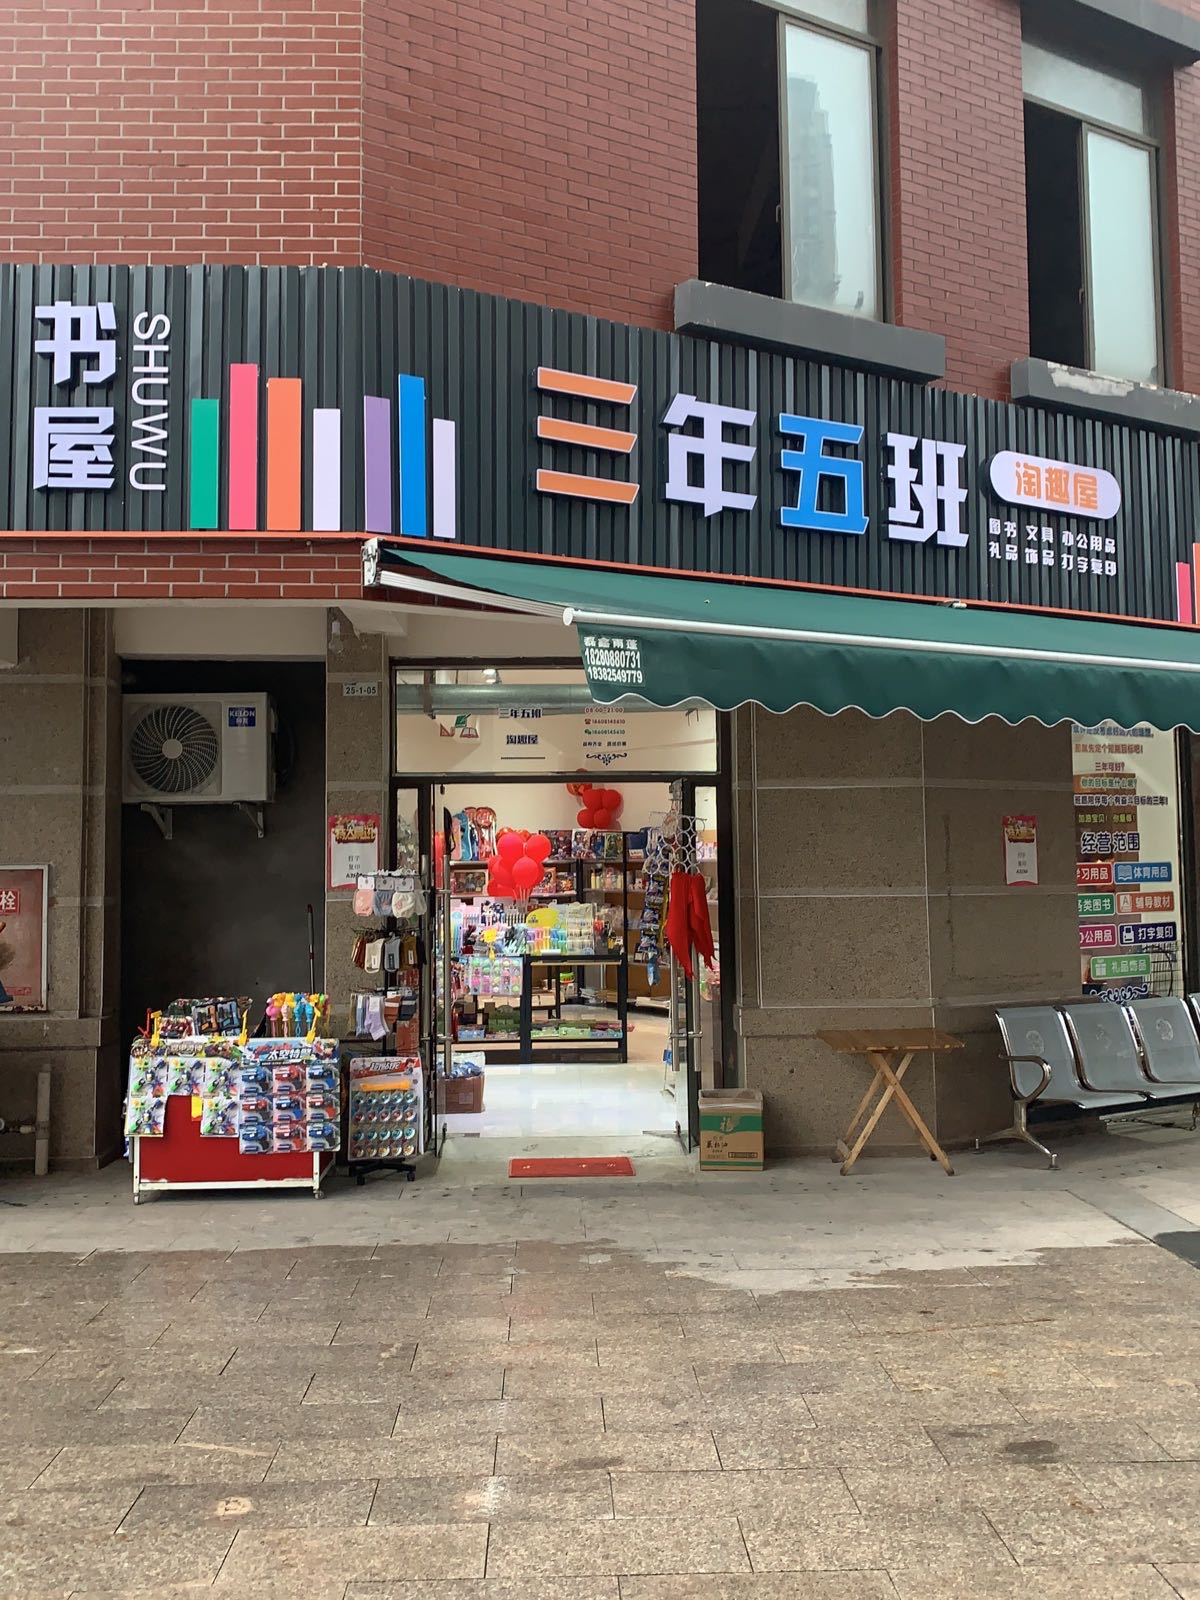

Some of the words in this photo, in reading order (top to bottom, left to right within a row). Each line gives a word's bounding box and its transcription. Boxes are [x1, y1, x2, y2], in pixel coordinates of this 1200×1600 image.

[34, 301, 116, 490] 书屋
[129, 311, 171, 491] SHUWU
[536, 366, 969, 548] 三年五班
[1015, 461, 1098, 510] 淘趣屋
[988, 517, 1017, 538] 图书
[1025, 524, 1054, 544] 文具
[1062, 530, 1116, 555] 办公用品
[988, 541, 1018, 561] 礼品
[1024, 547, 1055, 566] 饰品
[1061, 553, 1117, 577] 打字复印
[584, 647, 641, 669] 18280880731
[587, 666, 643, 684] 18382549779
[345, 686, 377, 695] 25-1-05
[1133, 866, 1169, 879] 体育用品
[1138, 926, 1174, 940] 打字复印
[1111, 958, 1147, 973] 礼品饰品
